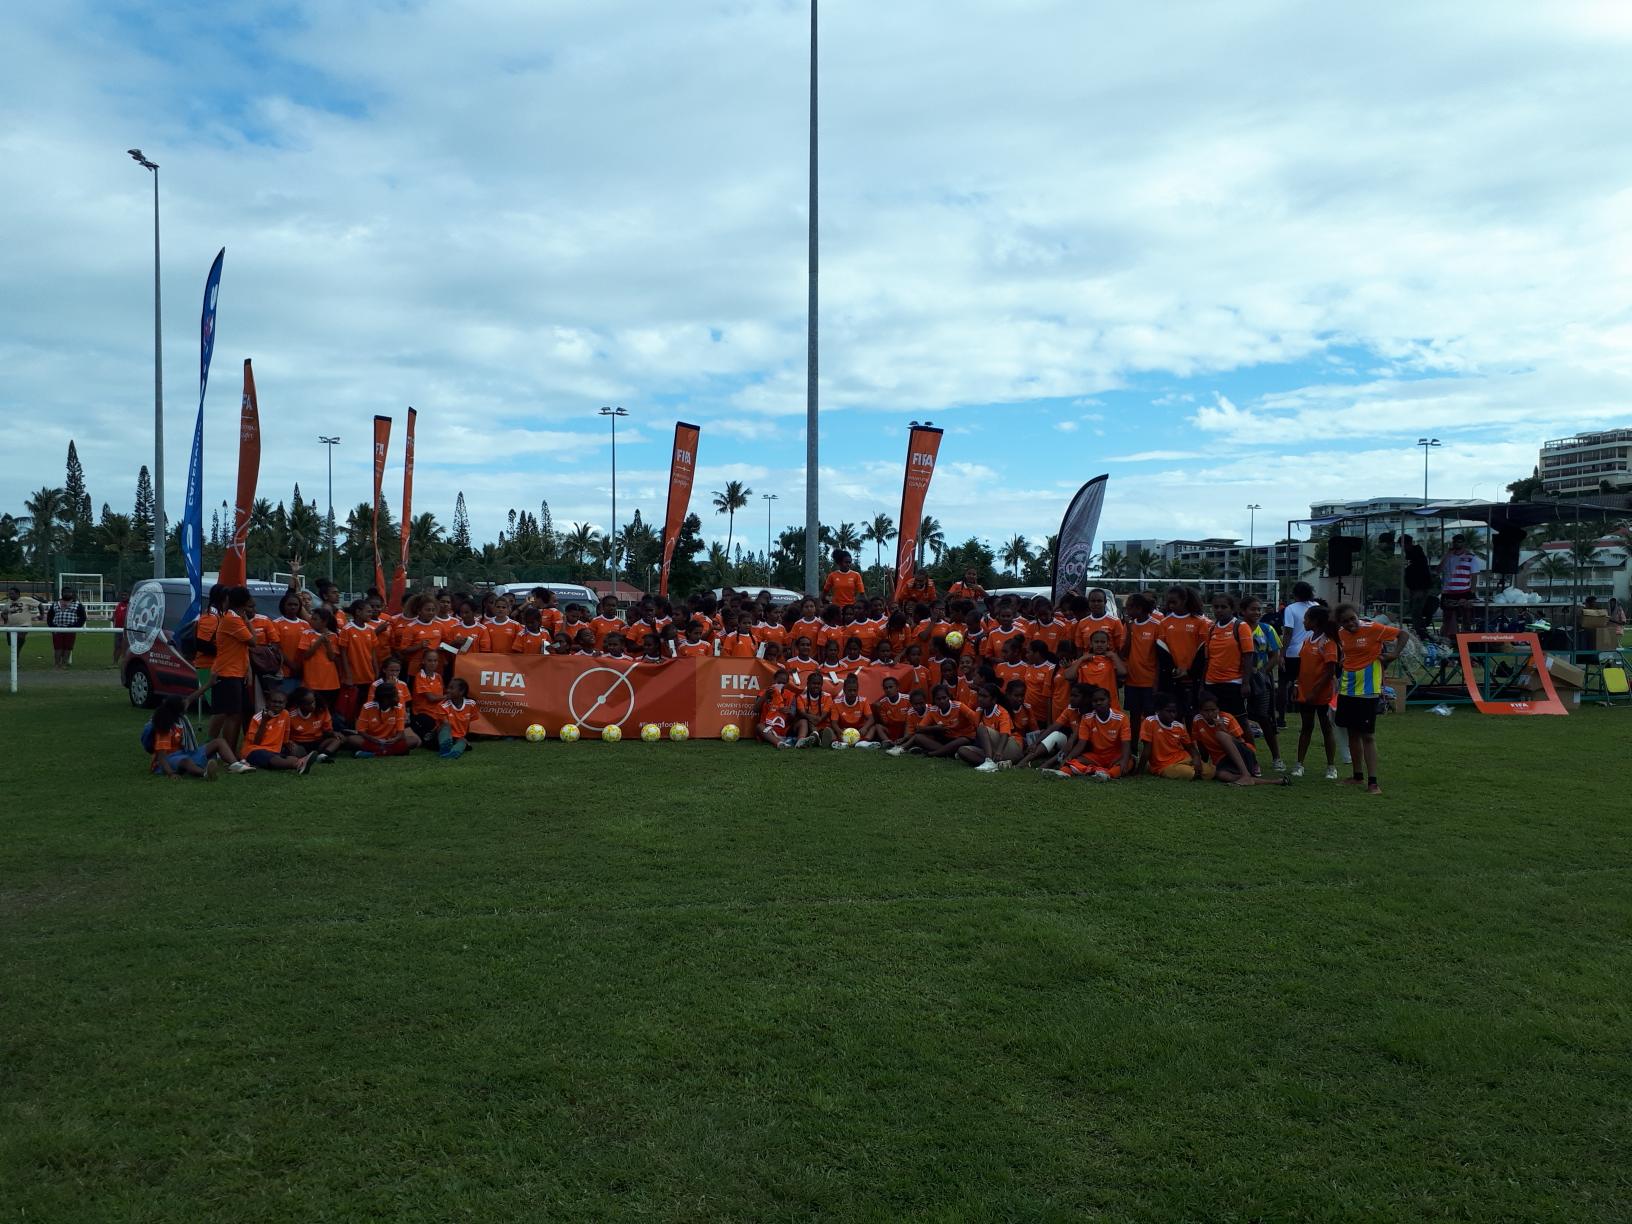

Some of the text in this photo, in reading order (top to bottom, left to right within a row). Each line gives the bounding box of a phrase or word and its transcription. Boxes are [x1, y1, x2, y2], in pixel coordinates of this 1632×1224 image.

[480, 671, 526, 689] FIFA
[720, 674, 761, 691] FIFA
[479, 706, 525, 718] campaign
